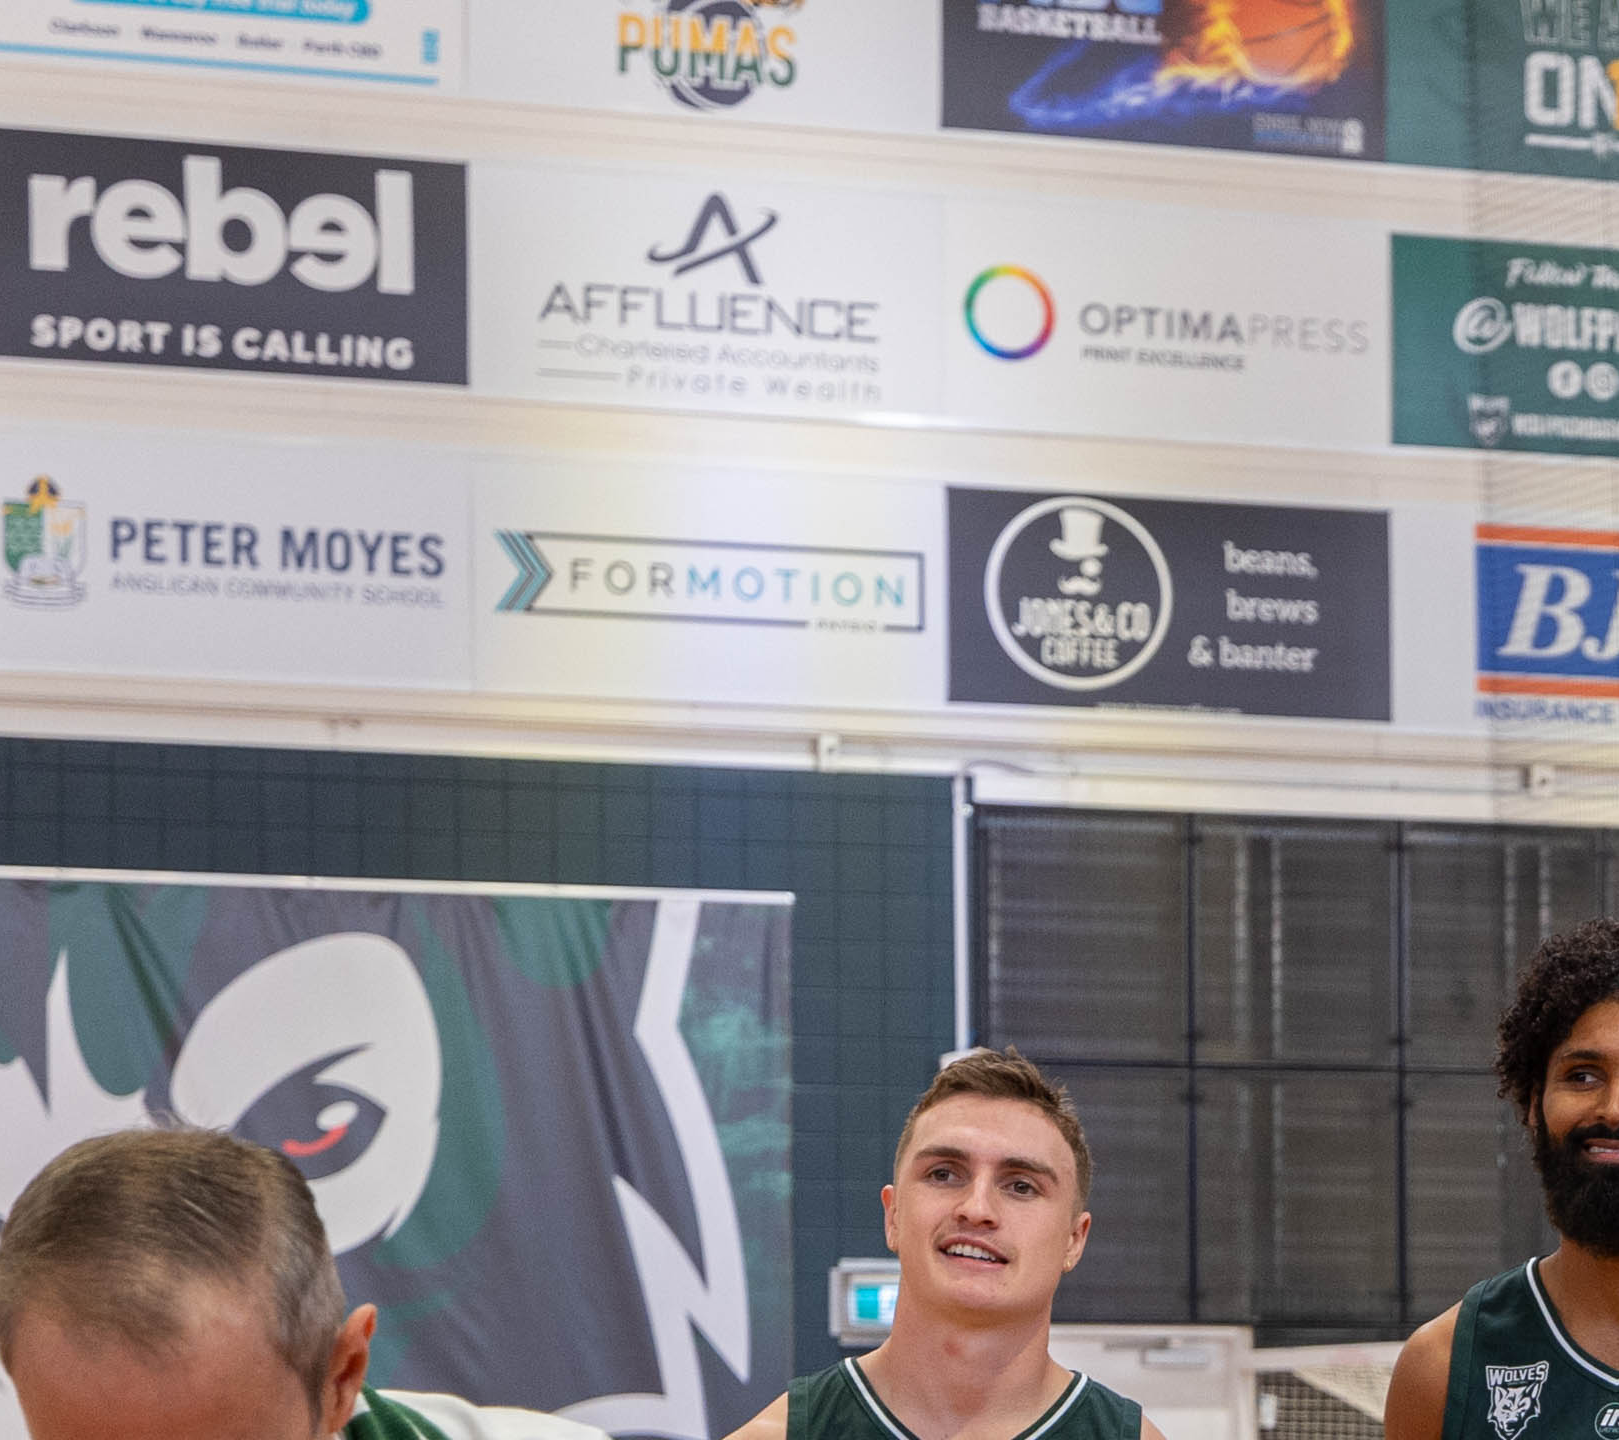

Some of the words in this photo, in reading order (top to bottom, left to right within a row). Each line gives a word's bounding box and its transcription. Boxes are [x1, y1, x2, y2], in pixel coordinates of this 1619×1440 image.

[979, 4, 1163, 43] BASKETBALL
[617, 13, 798, 87] PUMAS
[28, 154, 415, 296] rebel
[537, 281, 881, 344] AFFLUENCE
[30, 314, 172, 355] SPORT
[182, 323, 223, 360] IS
[232, 327, 415, 371] CALLING
[575, 334, 711, 364] Chartered
[717, 344, 880, 374] Accountants
[626, 364, 749, 396] Private
[765, 375, 882, 404] Wealth
[109, 517, 260, 570] PETER
[281, 526, 446, 579] MOYES
[110, 572, 220, 596] ANGLICAN
[223, 576, 356, 603] COMMUNITY
[360, 584, 446, 609] SCHOOL
[569, 557, 906, 609] FORMOTION
[1225, 588, 1321, 625] brews
[1040, 636, 1121, 669] COFFEE
[1187, 634, 1215, 669] &
[1218, 635, 1319, 673] banter
[1473, 696, 1617, 726] INSURANCE
[1489, 1364, 1547, 1387] WOLVES
